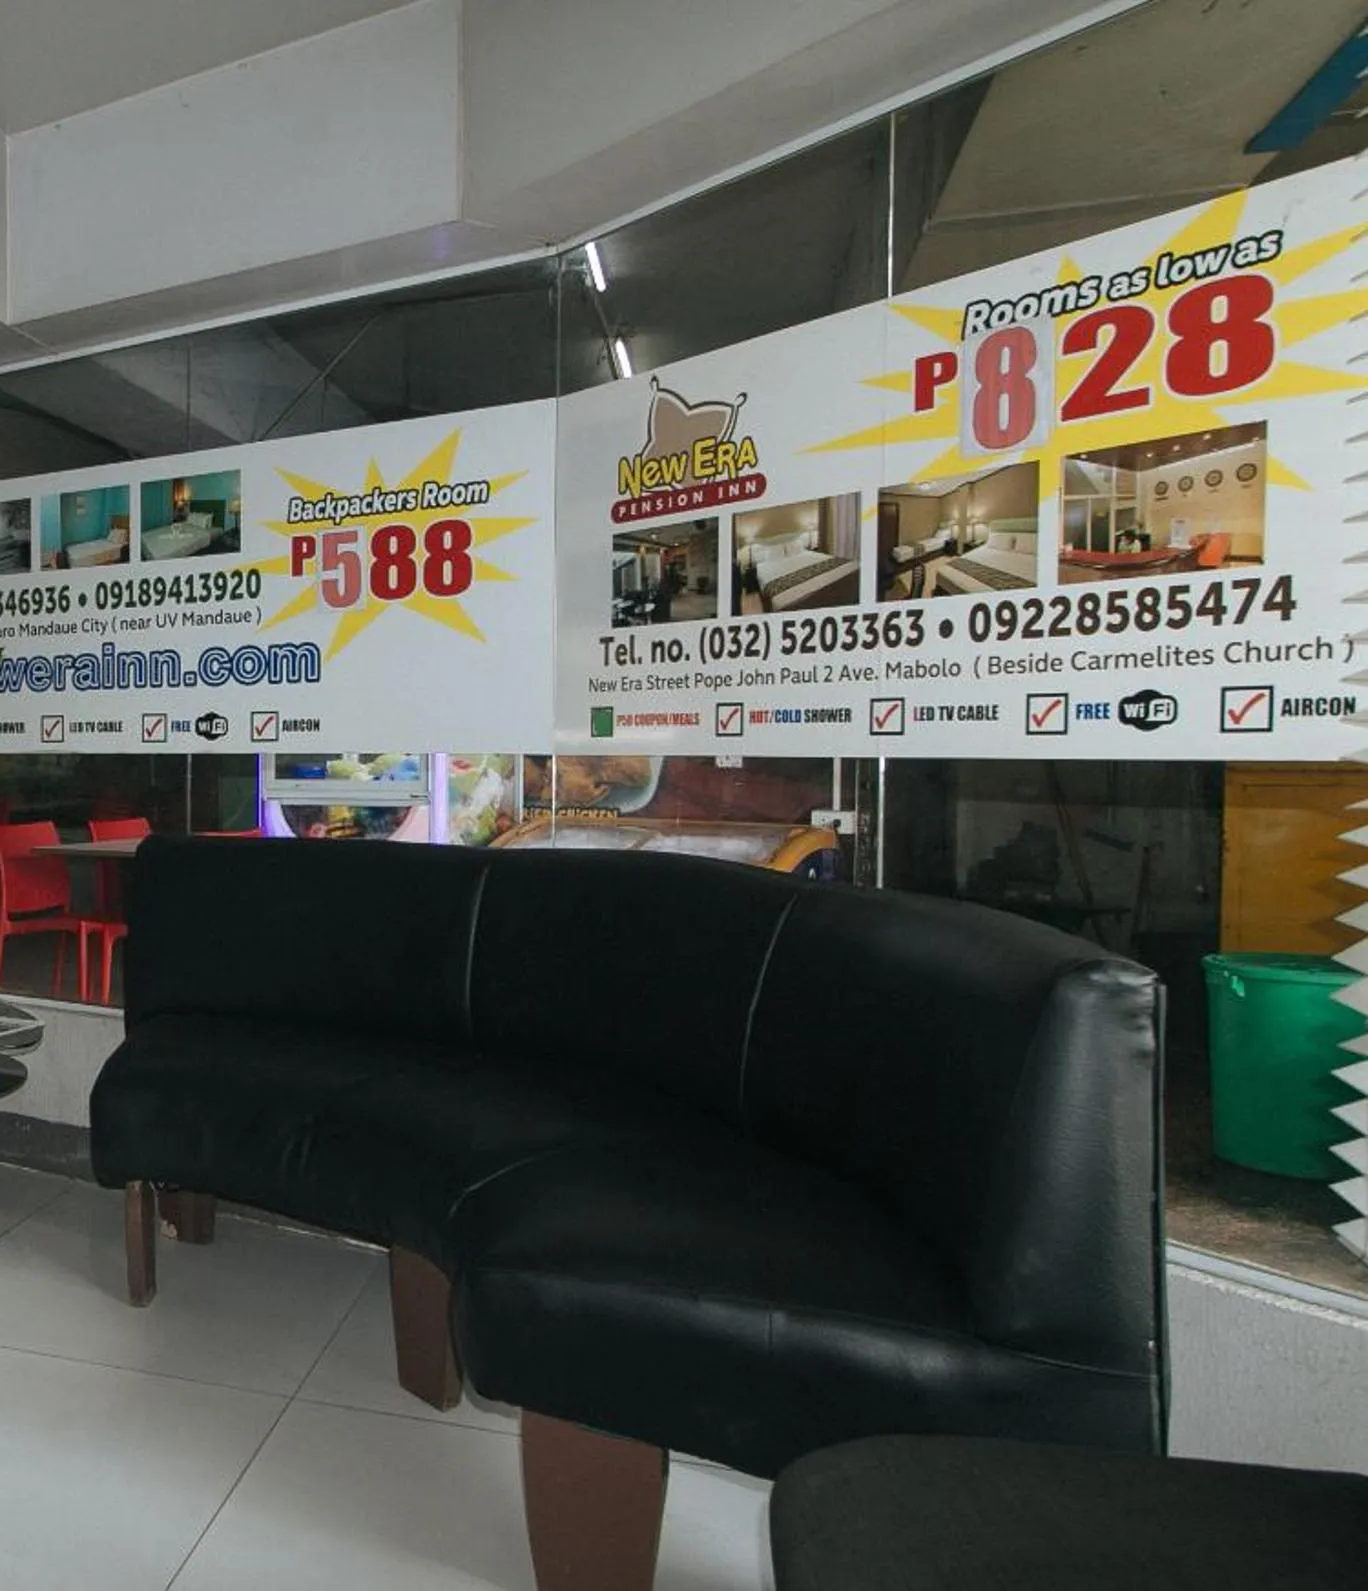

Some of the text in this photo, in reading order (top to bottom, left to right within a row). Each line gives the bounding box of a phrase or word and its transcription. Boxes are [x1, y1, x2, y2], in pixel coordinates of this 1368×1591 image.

[962, 230, 1283, 340] Rooms as low as
[618, 436, 758, 499] New ERA
[288, 480, 490, 525] Backpackers Room
[618, 480, 758, 519] PENSION INN
[95, 568, 262, 611] 09189413920
[19, 621, 78, 638] Mandaue
[82, 617, 109, 637] City
[155, 613, 179, 628] UV
[182, 608, 253, 626] Mandaue
[599, 574, 1297, 667] Tel. no. (032) 5203363 09228585474
[588, 677, 617, 693] New
[621, 676, 643, 692] Era
[646, 673, 690, 690] Street
[694, 671, 733, 693] Pope
[736, 668, 775, 687] John
[780, 665, 819, 685] Paul
[823, 664, 833, 684] 2
[838, 664, 879, 682] Ave.
[885, 658, 962, 680] Mabolo
[988, 652, 1063, 675] Beside
[1070, 644, 1215, 672] Carmelites
[1224, 635, 1333, 664] Church
[749, 707, 853, 725] HOT/COLD SHOWER
[913, 704, 999, 722] LED TV CABLE
[1075, 702, 1111, 721] FREE
[1281, 696, 1357, 718] AIRCON
[96, 720, 123, 733] CABLE
[171, 719, 191, 733] FREE
[282, 718, 321, 733] AIRCON
